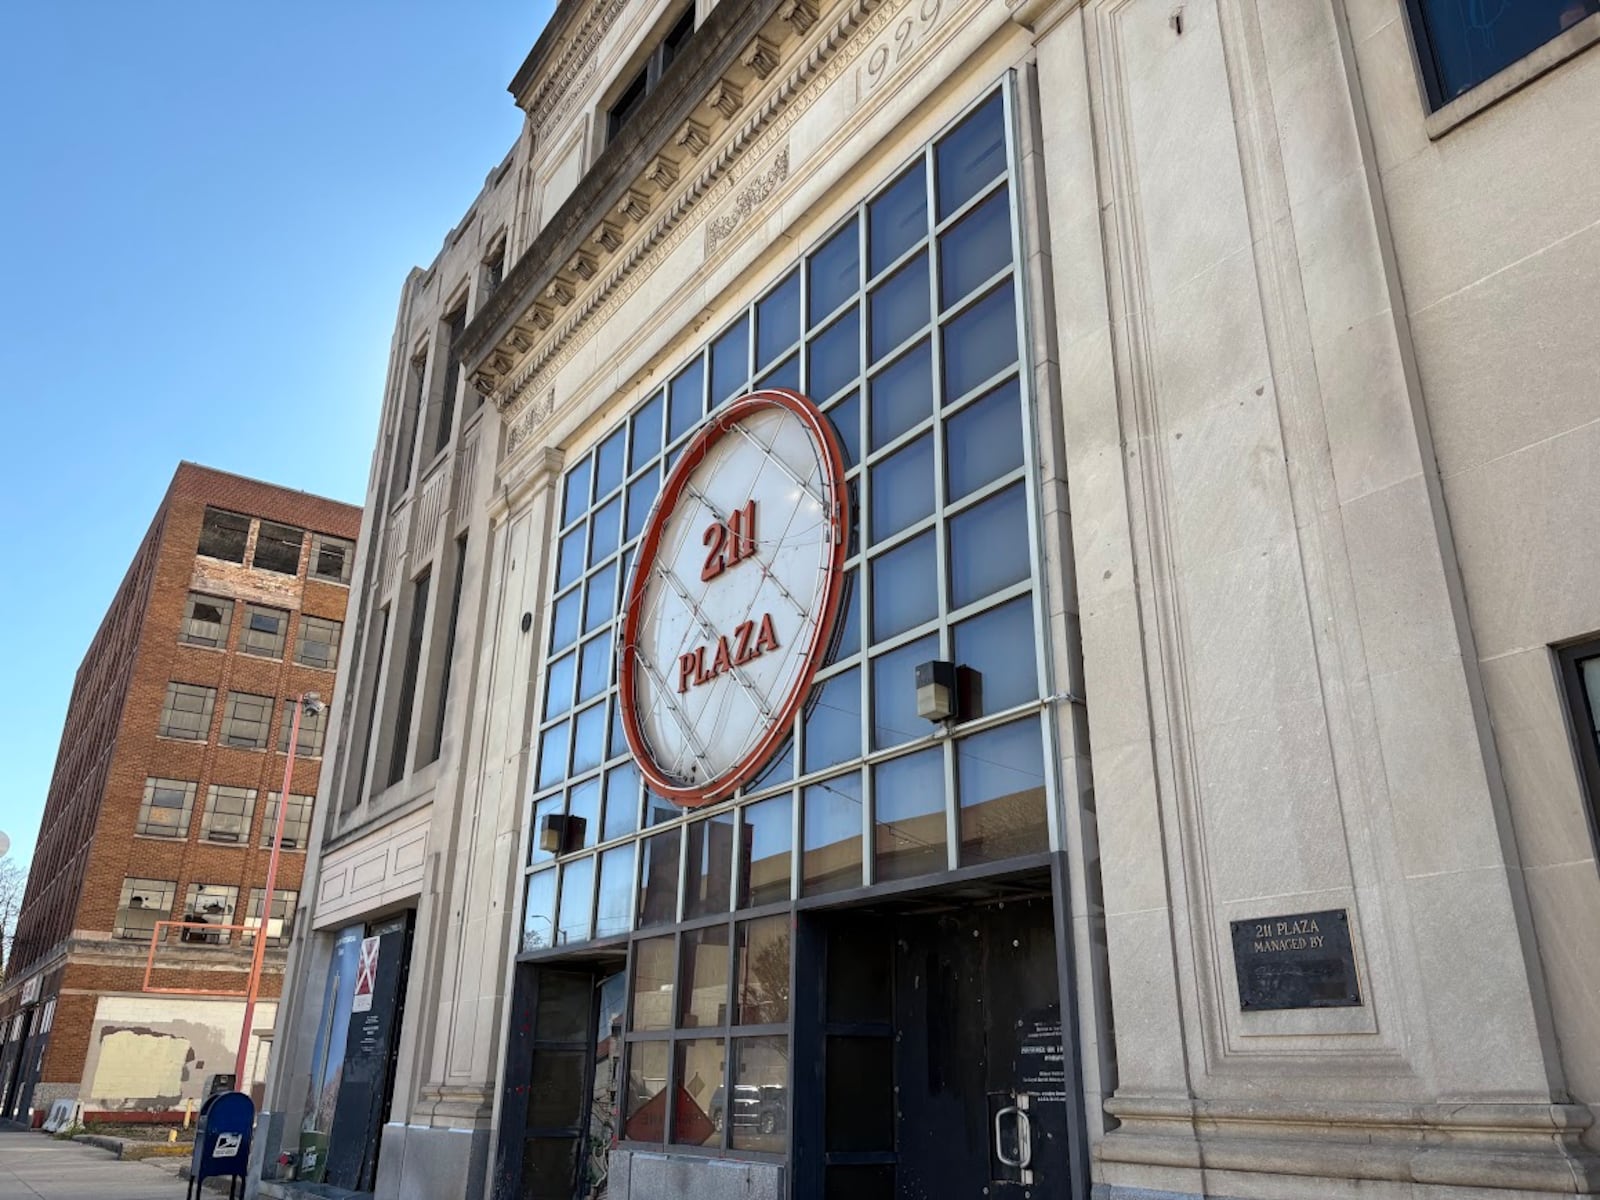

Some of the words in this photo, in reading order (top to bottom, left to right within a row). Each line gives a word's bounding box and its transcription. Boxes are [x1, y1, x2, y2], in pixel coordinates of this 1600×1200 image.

[855, 0, 940, 105] 1929
[701, 499, 756, 583] 211
[677, 612, 780, 694] PLAZA
[1254, 938, 1307, 953] MANAGED
[1310, 935, 1324, 949] BY
[1256, 924, 1272, 938] 211
[1277, 919, 1320, 936] PLAZA
